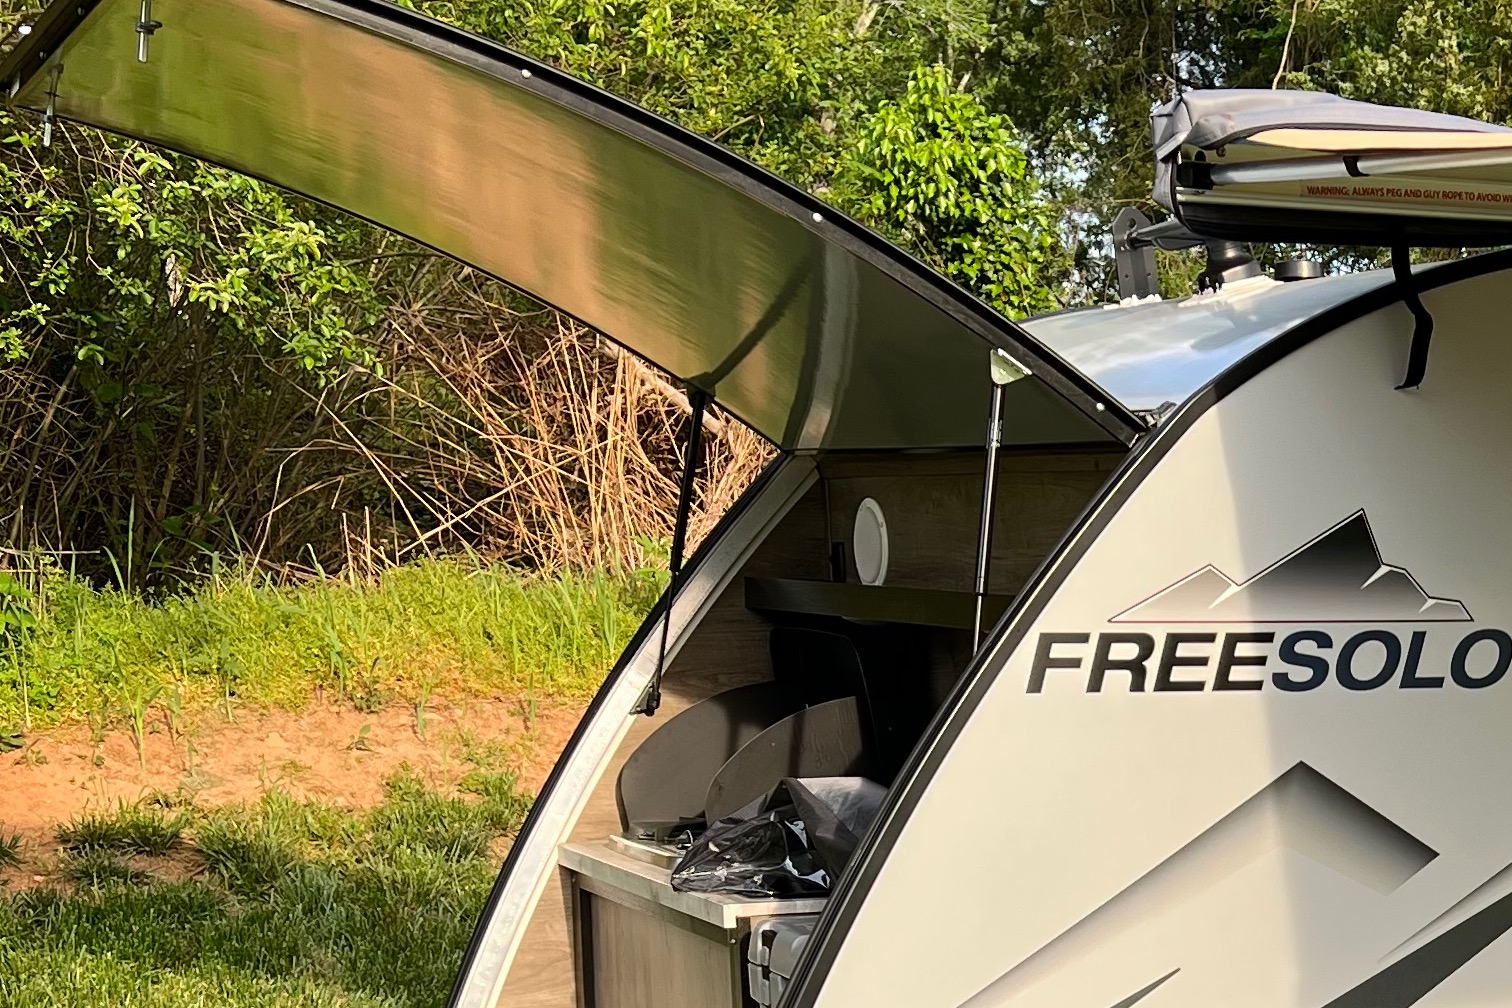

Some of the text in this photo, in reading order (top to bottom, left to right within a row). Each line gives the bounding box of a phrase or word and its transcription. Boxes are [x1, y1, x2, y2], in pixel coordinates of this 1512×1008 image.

[1306, 185, 1350, 197] WARNING:
[1352, 186, 1385, 198] ALWAYS
[1386, 187, 1403, 199] PEG
[1404, 188, 1422, 200] AND
[1423, 189, 1442, 200] GUY
[1442, 190, 1464, 202] ROPE
[1464, 191, 1476, 202] TO
[1476, 192, 1502, 203] AVOID
